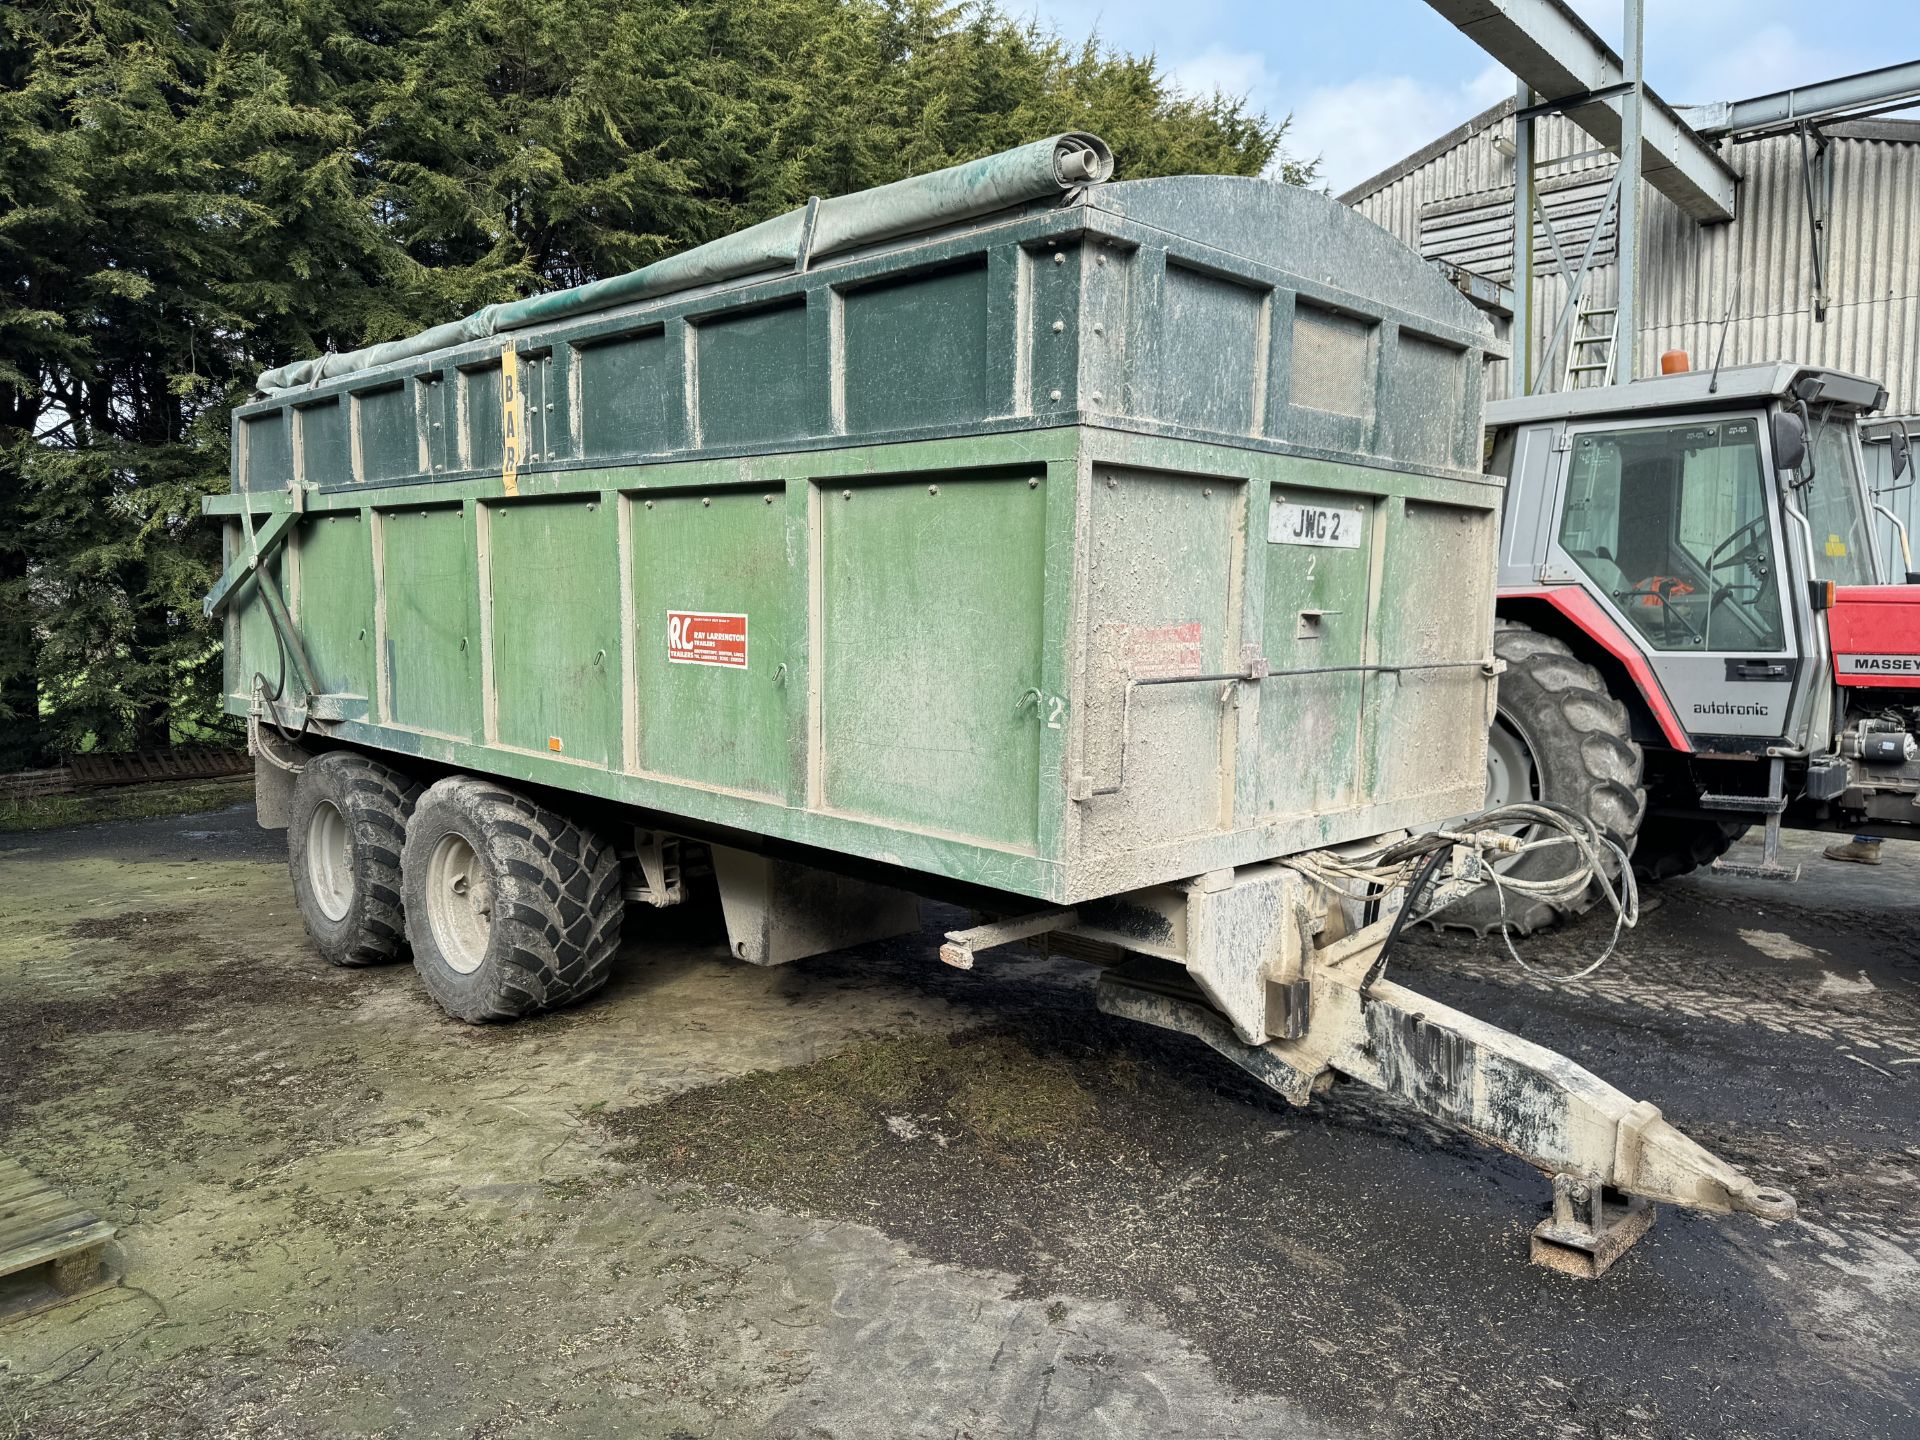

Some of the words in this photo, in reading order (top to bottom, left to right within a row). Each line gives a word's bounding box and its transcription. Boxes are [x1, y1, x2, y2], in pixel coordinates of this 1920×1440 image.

[505, 374, 515, 472] BAR
[1293, 509, 1327, 539] JWG
[1330, 513, 1341, 540] 2
[1306, 553, 1317, 580] 2
[670, 616, 694, 650] RC
[1855, 659, 1920, 670] MASSEY
[1048, 696, 1062, 730] 2
[1693, 701, 1768, 716] autotronic
